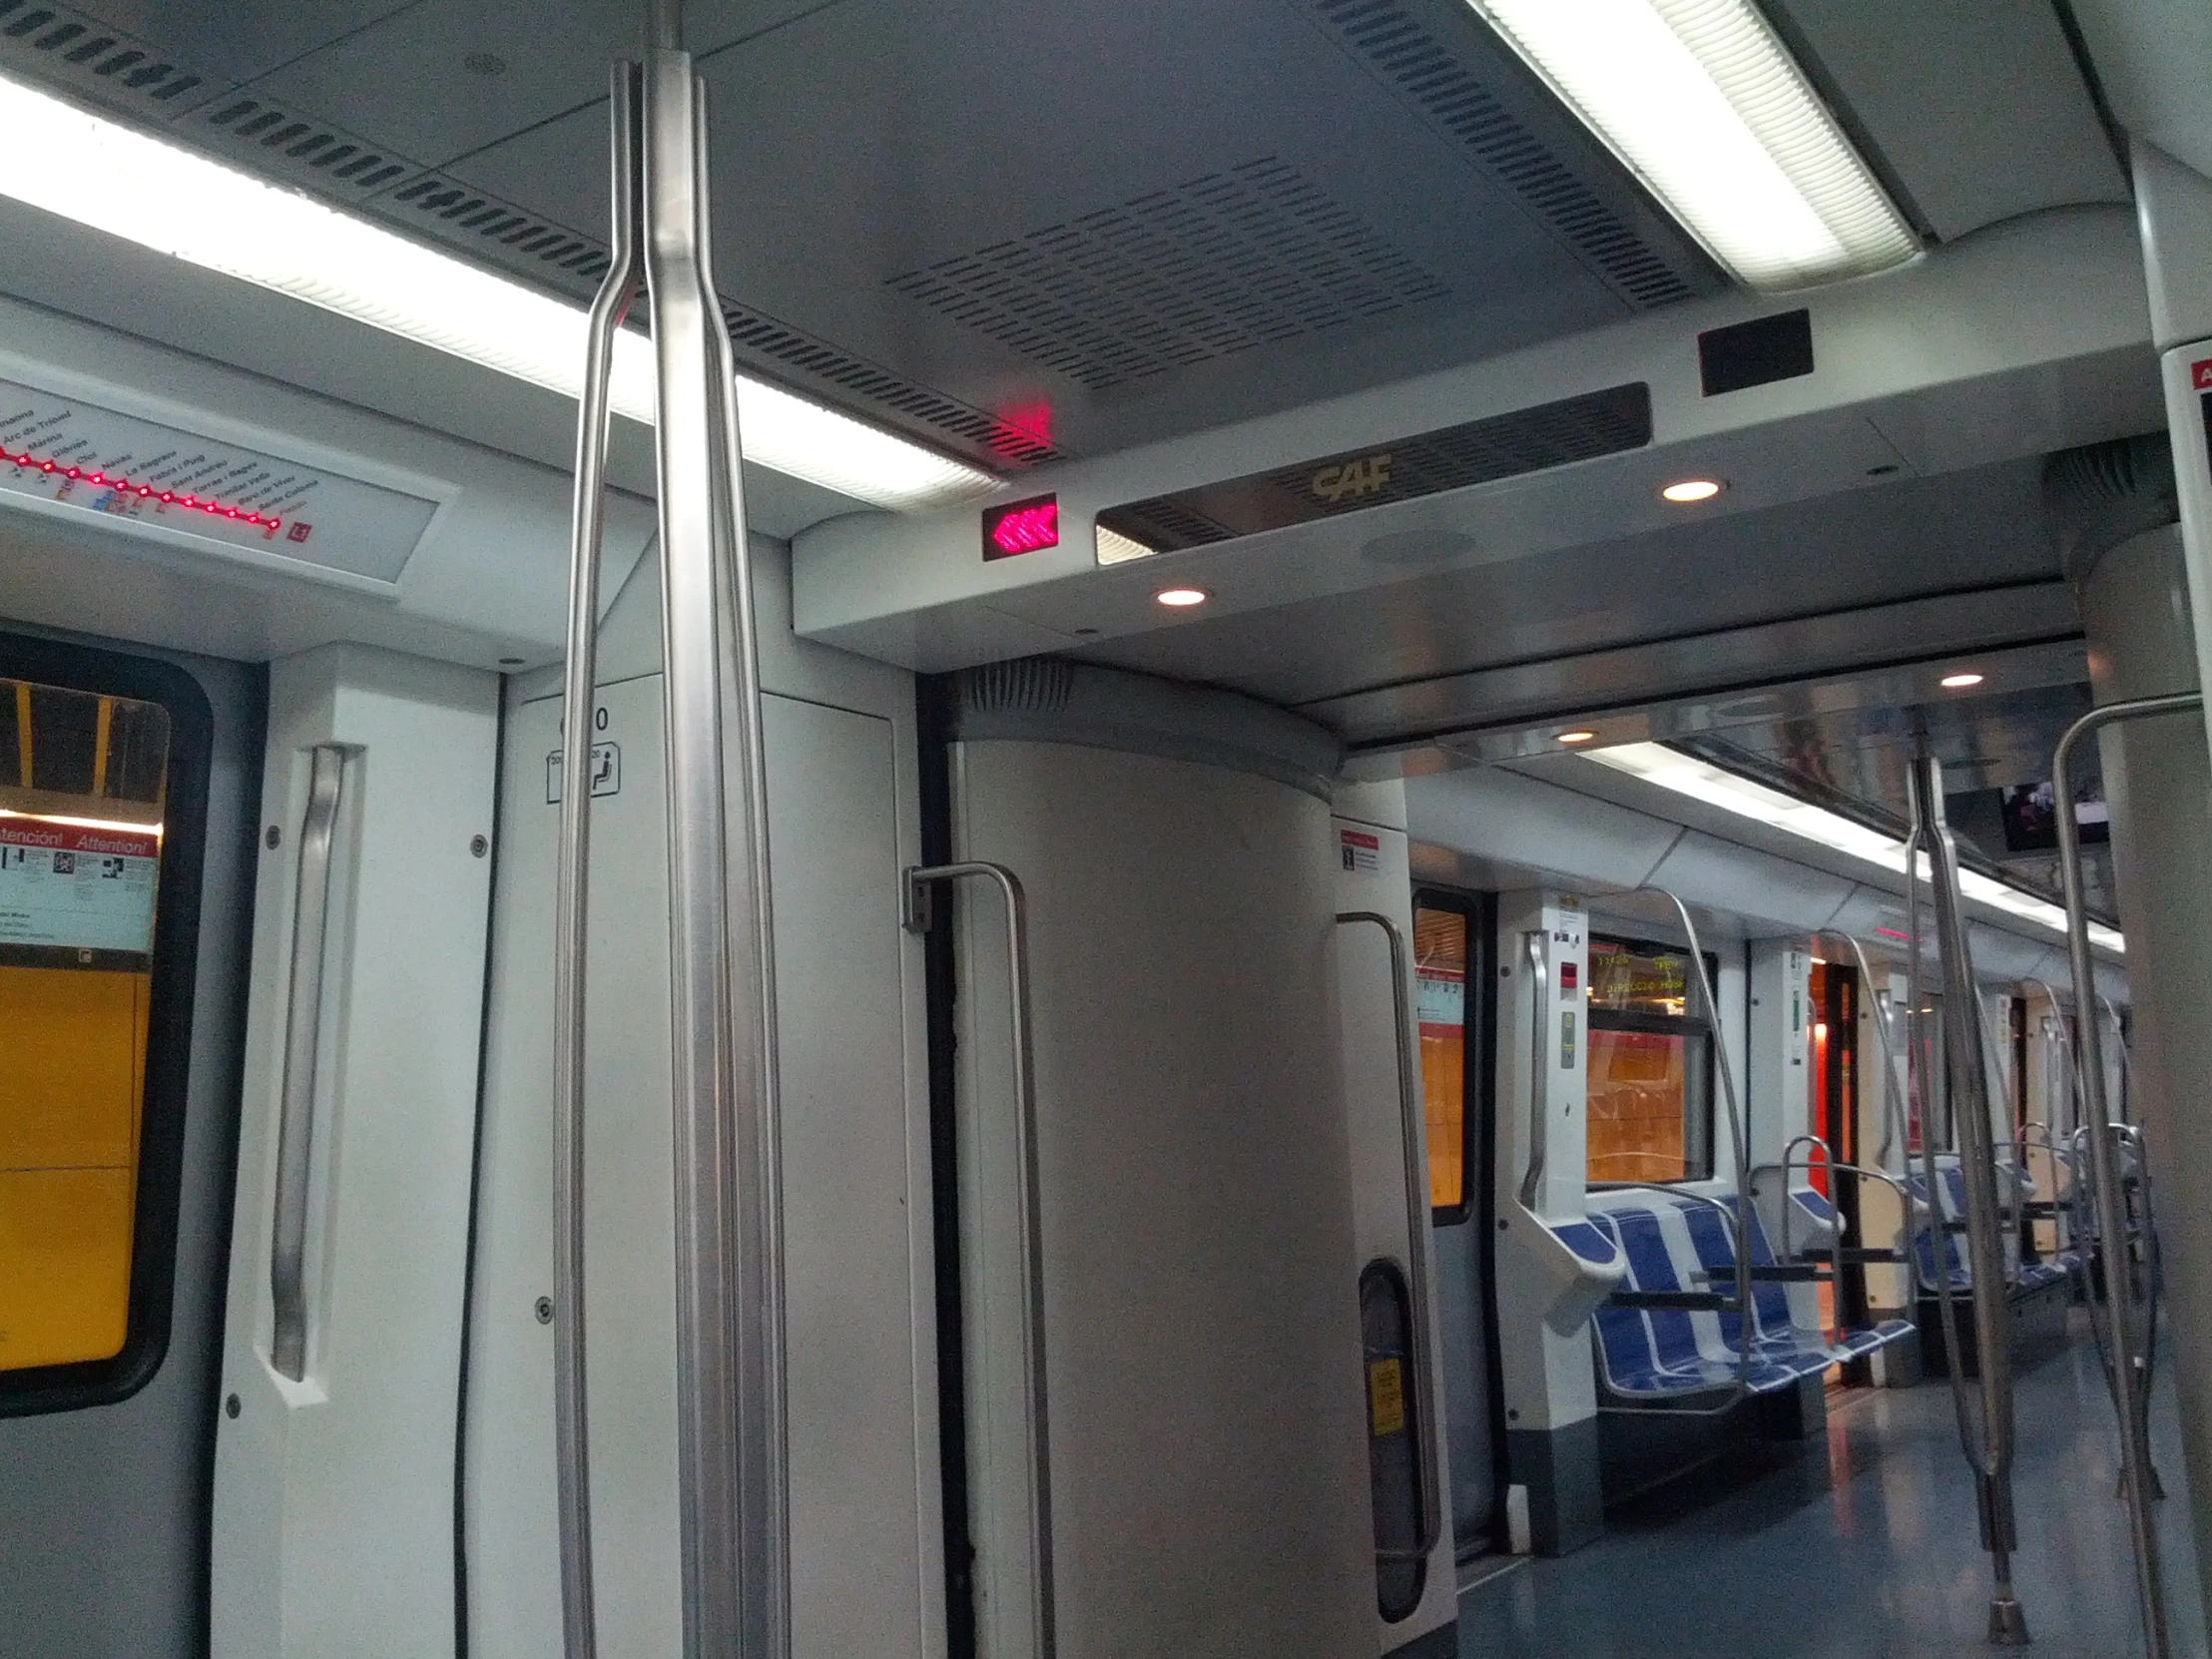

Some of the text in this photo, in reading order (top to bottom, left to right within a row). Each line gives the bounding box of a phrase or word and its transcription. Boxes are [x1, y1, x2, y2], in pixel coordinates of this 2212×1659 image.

[4, 433, 21, 444] Arc
[23, 426, 36, 436] de
[27, 433, 62, 451] Marina
[76, 452, 97, 465] Clot
[102, 454, 133, 470] Navas
[140, 451, 177, 470] Sagrera
[149, 467, 177, 482] Fabra
[171, 460, 228, 489] Sant Andreu
[1313, 454, 1391, 502] CAF
[0, 828, 148, 855] tención! Attention!
